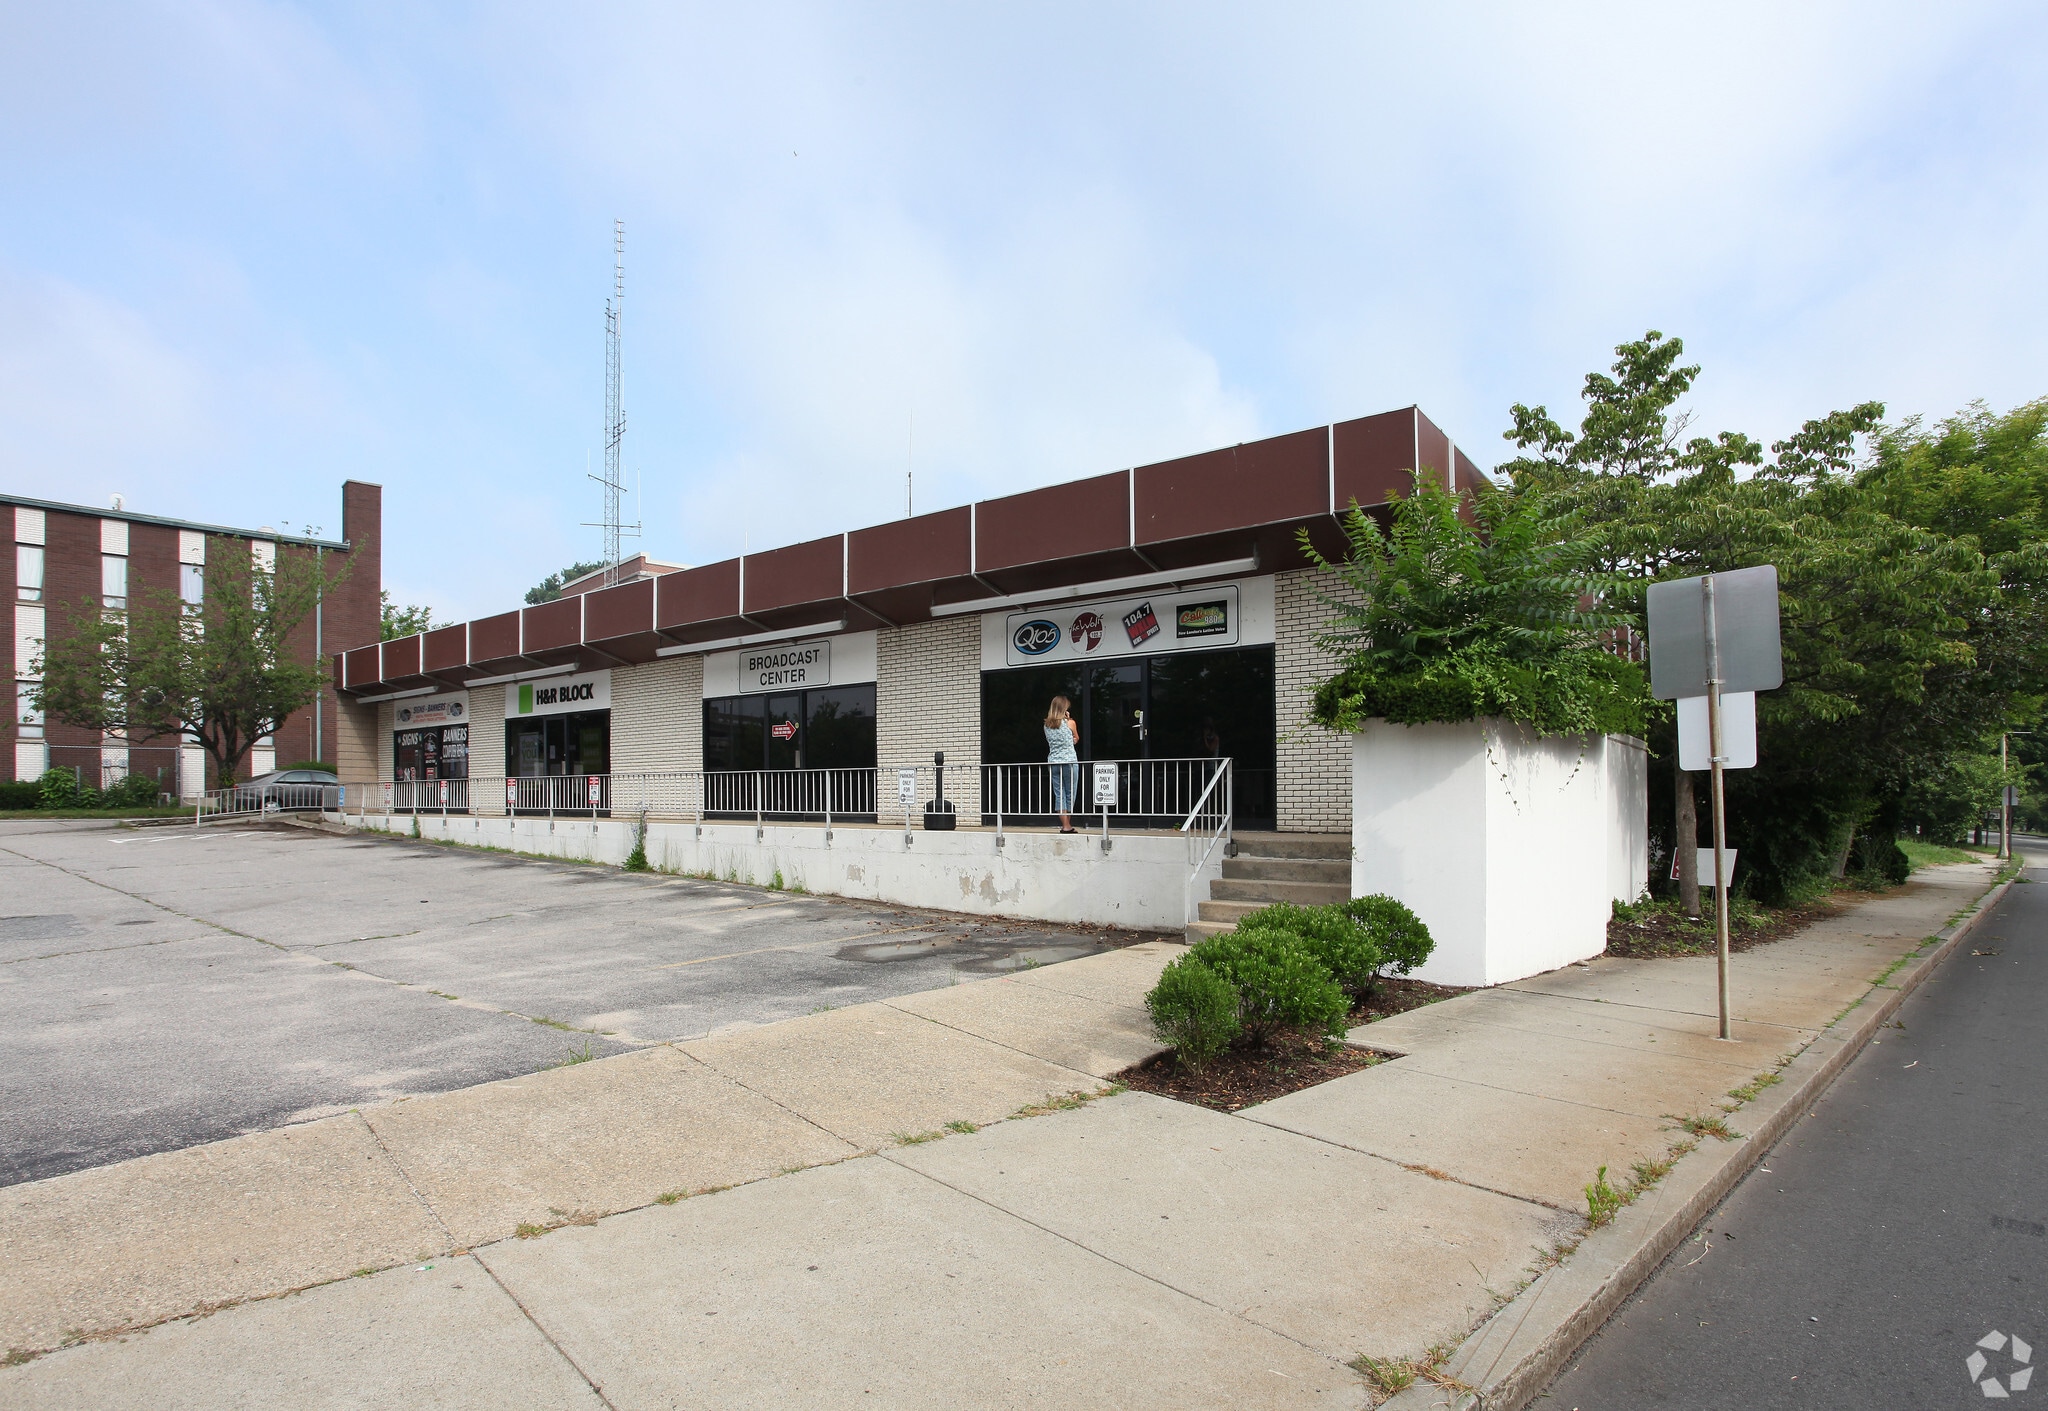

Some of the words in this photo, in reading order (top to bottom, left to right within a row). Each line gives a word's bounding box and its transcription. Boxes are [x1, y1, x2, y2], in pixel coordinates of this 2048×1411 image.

[1124, 603, 1151, 627] 104.7
[1205, 615, 1218, 625] 980
[1014, 625, 1058, 650] Q105
[749, 649, 820, 671] BROADCAST
[760, 668, 806, 686] CENTER
[536, 688, 557, 705] H&R
[560, 683, 594, 703] BLOCK
[402, 733, 418, 746] SIGNS
[443, 727, 468, 743] BANNERS
